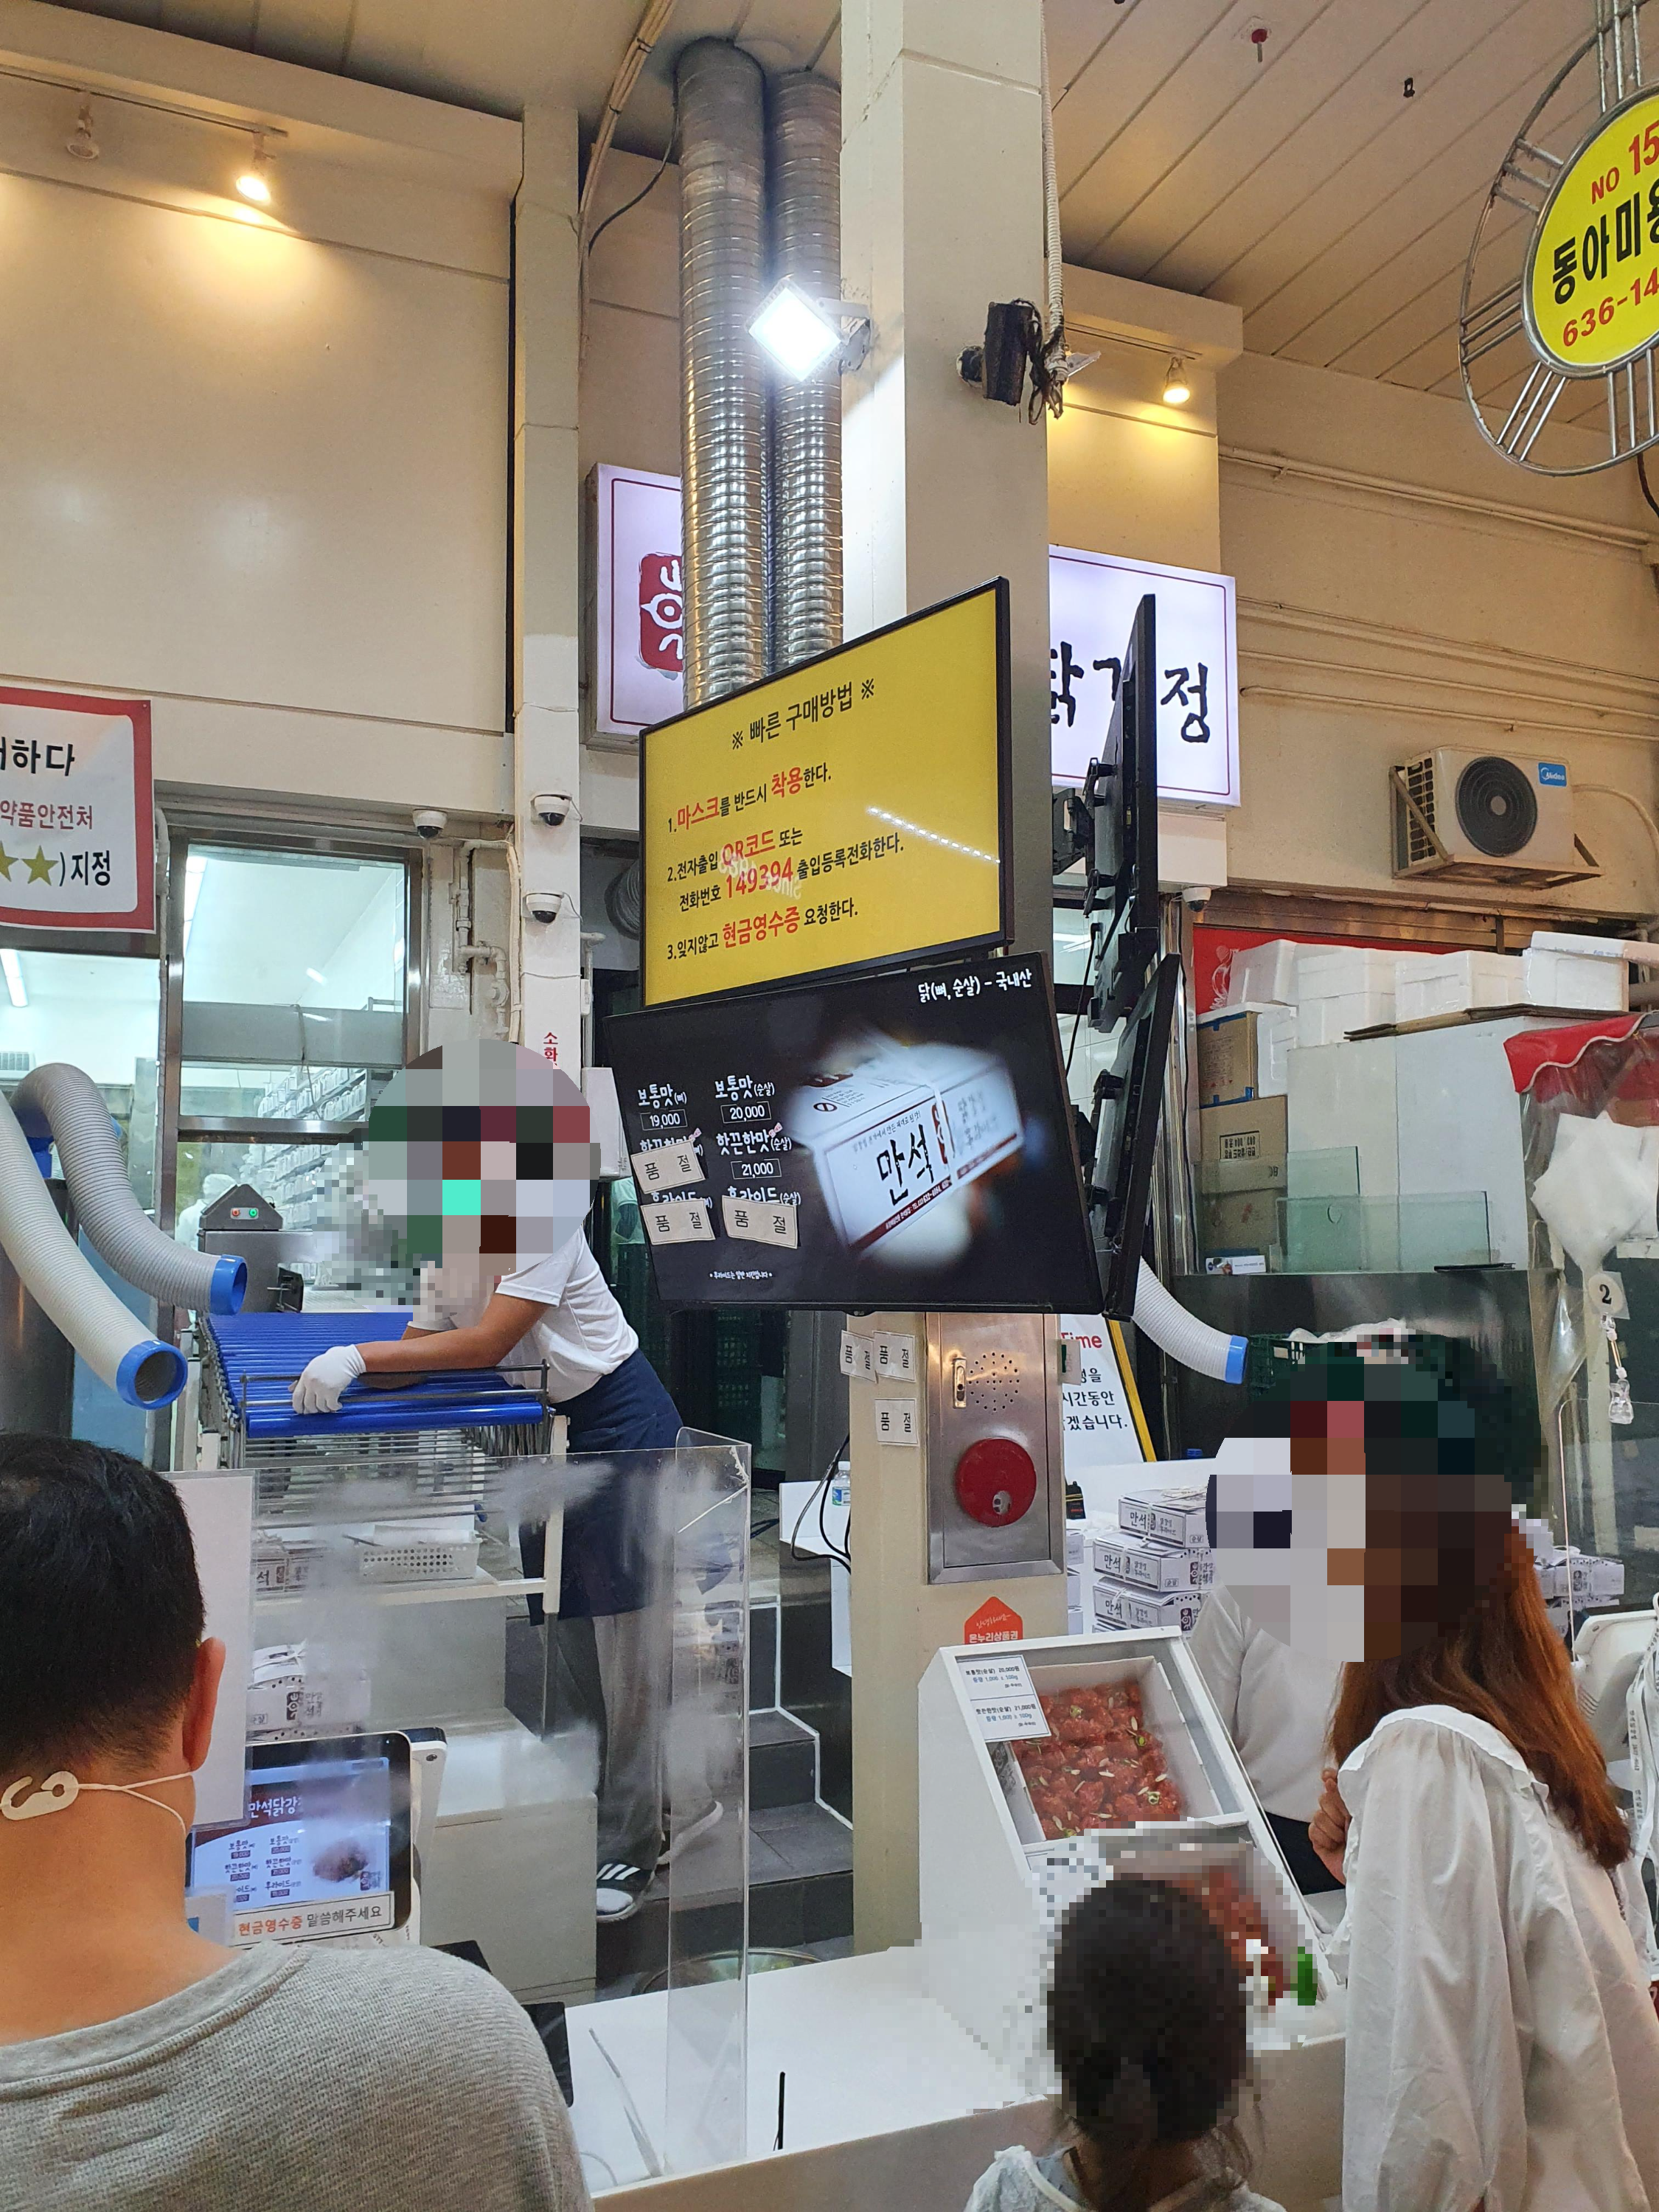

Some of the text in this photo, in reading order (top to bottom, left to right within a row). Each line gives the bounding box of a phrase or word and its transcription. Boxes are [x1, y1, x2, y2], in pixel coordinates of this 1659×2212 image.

[1591, 167, 1620, 205] NO
[750, 711, 782, 743] 빠른
[786, 681, 852, 731] 구매방법
[0, 737, 75, 776] 하다
[734, 783, 767, 812] 반드시
[771, 762, 832, 798] 착용한다.
[721, 830, 776, 866] QR코드
[779, 827, 803, 847] 또는
[679, 832, 904, 912] 전화번호 149394 출입등록전화한다.
[723, 906, 801, 949] 현금영수증
[804, 897, 859, 926] 요청한다.
[995, 968, 1032, 991] 국내산
[543, 1032, 559, 1066] 소화
[714, 1074, 775, 1102] 보통맛(순살)
[649, 1112, 681, 1130] 19,000
[729, 1105, 765, 1122] 20,000
[644, 1162, 661, 1181] 품
[677, 1154, 692, 1173] 절
[741, 1162, 774, 1178] 21,000
[876, 1123, 935, 1207] 만석
[655, 1211, 703, 1233] 품 절
[734, 1209, 787, 1235] 품 절
[1599, 1284, 1613, 1305] 2
[845, 1345, 871, 1370] 품 절
[880, 1345, 909, 1368] 품 절
[880, 1412, 911, 1433] 품 절
[1063, 1413, 1128, 1431] 겠습니다.
[1130, 1512, 1147, 1530] 만석
[1105, 1554, 1121, 1573] 만석
[1105, 1599, 1123, 1619] 만석
[969, 1630, 1018, 1644] 온누리상품권
[307, 1905, 382, 1928] 말씀해주세요
